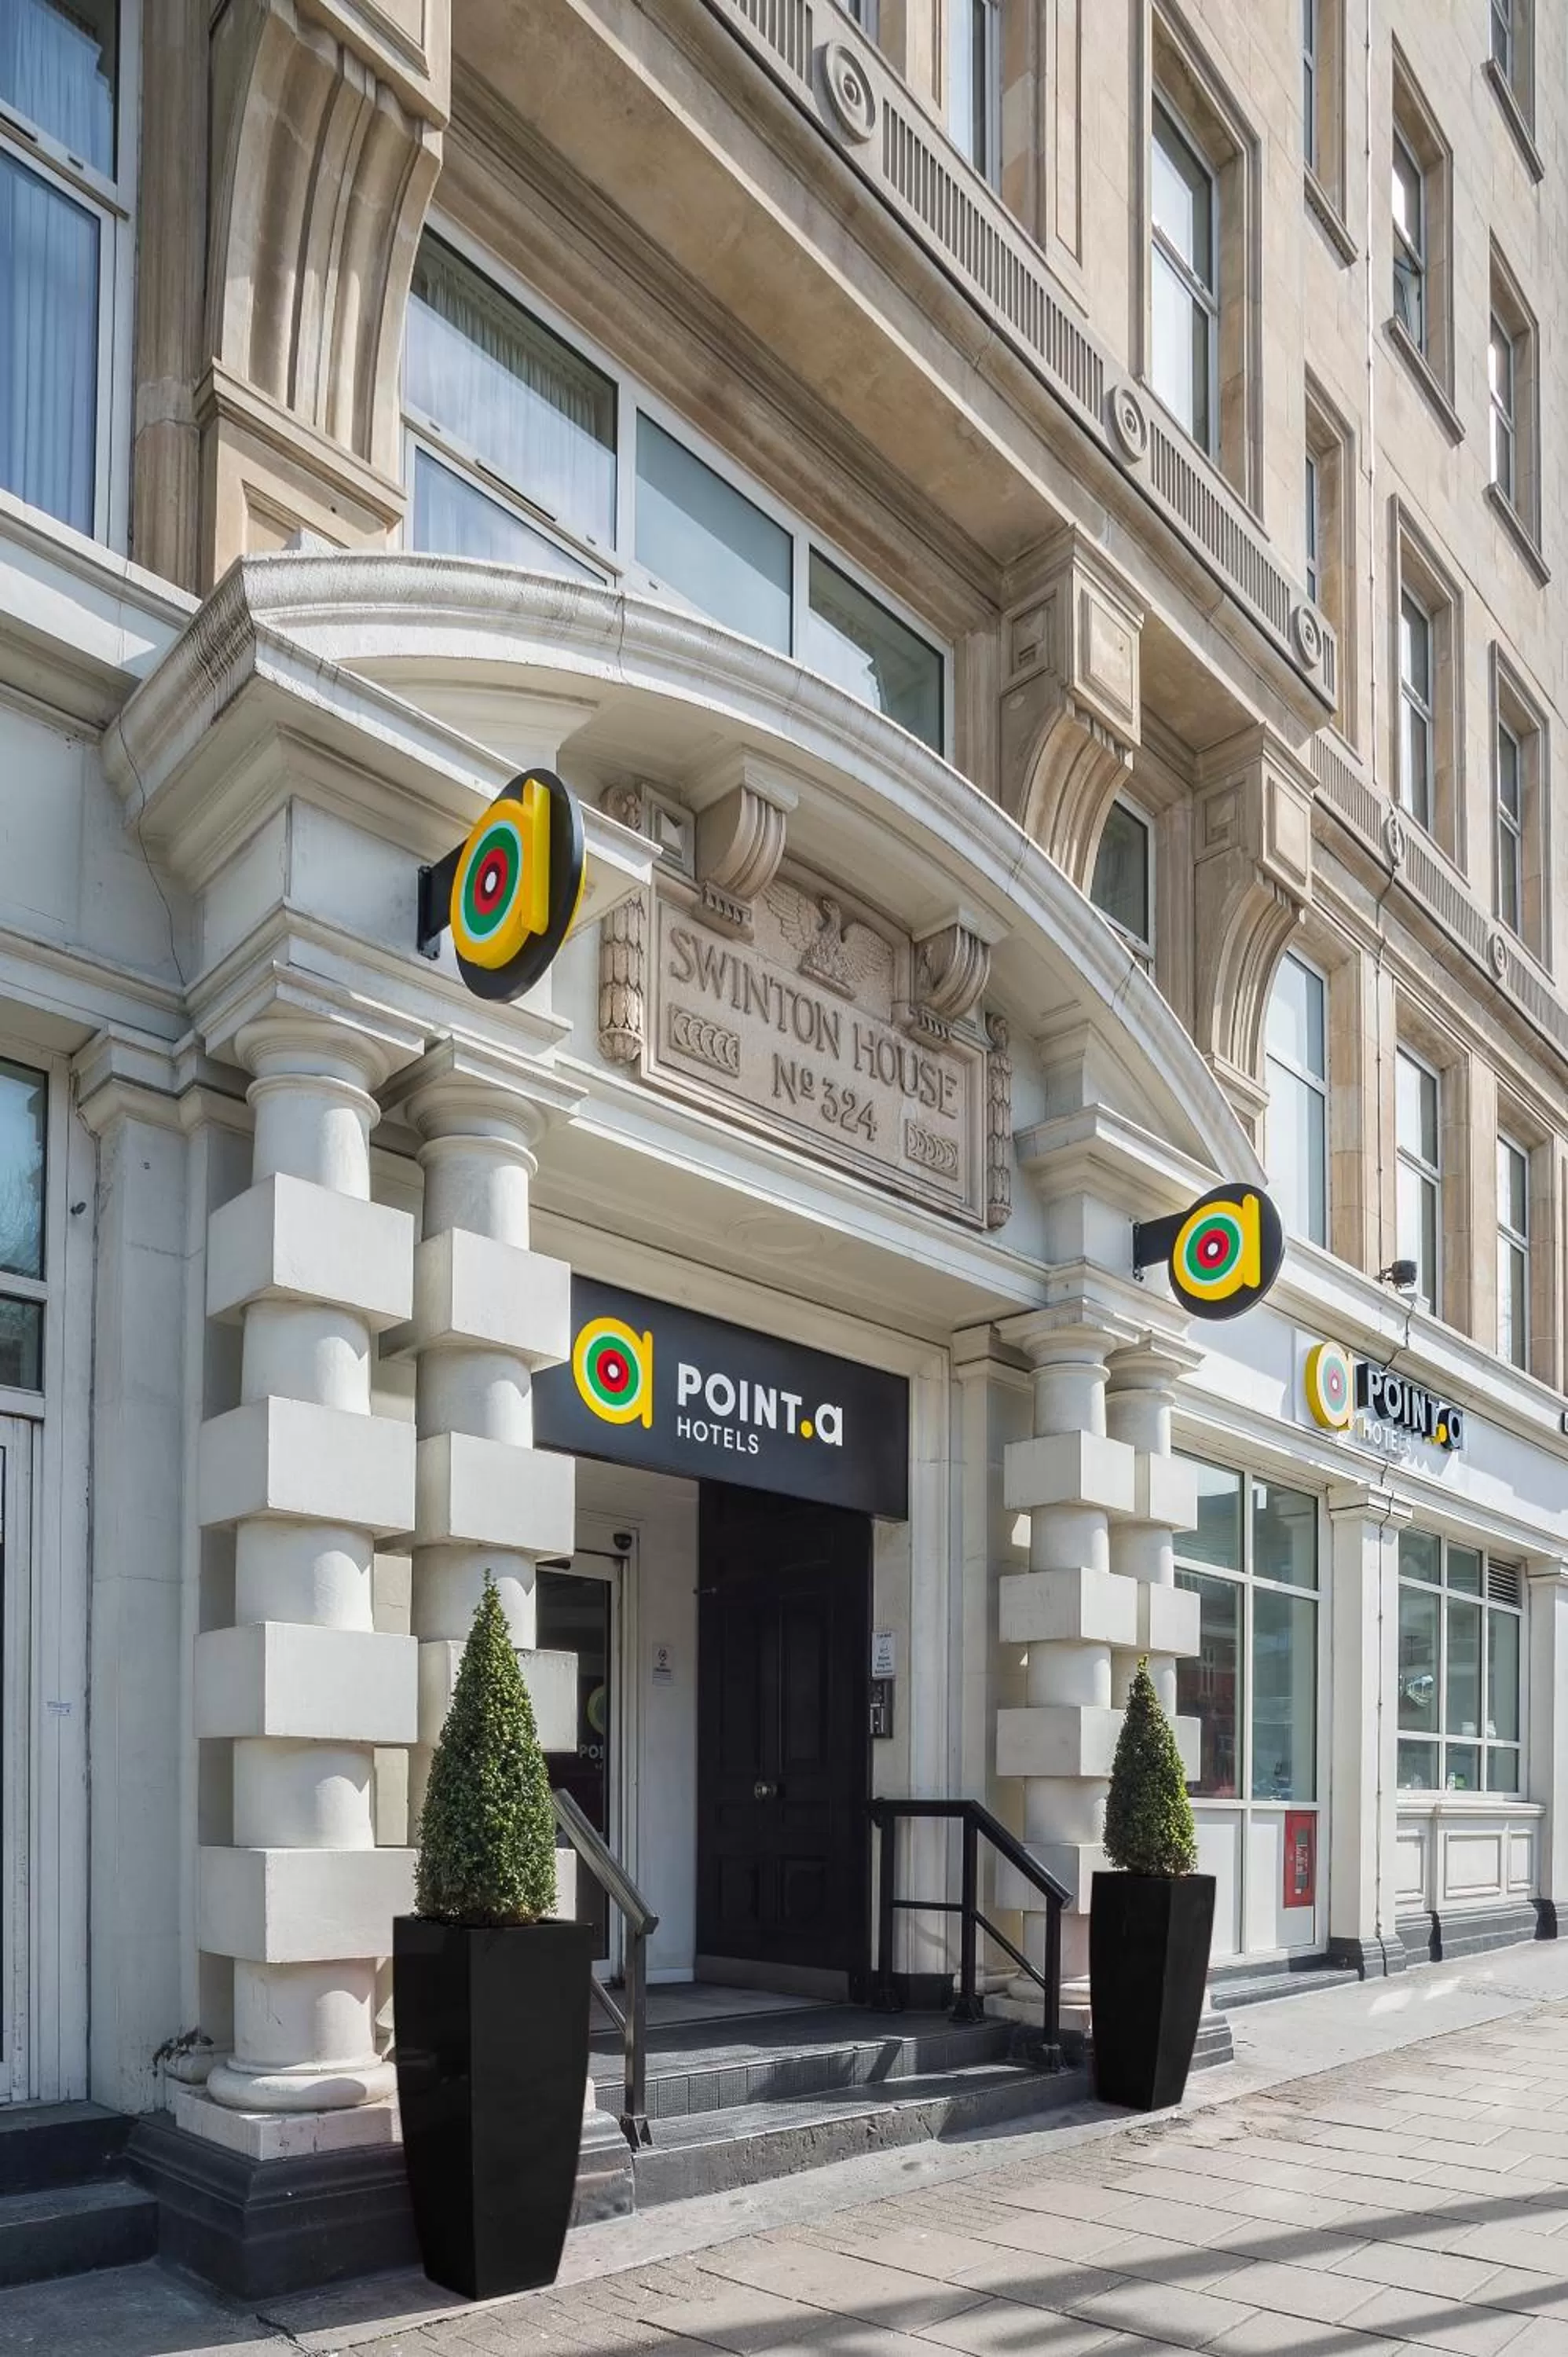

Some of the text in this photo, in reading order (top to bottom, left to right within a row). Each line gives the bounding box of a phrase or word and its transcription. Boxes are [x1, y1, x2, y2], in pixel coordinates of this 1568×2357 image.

[669, 926, 958, 1120] SWINTON HOUSE
[820, 1079, 878, 1142] 324
[677, 1416, 760, 1454] HOTELS
